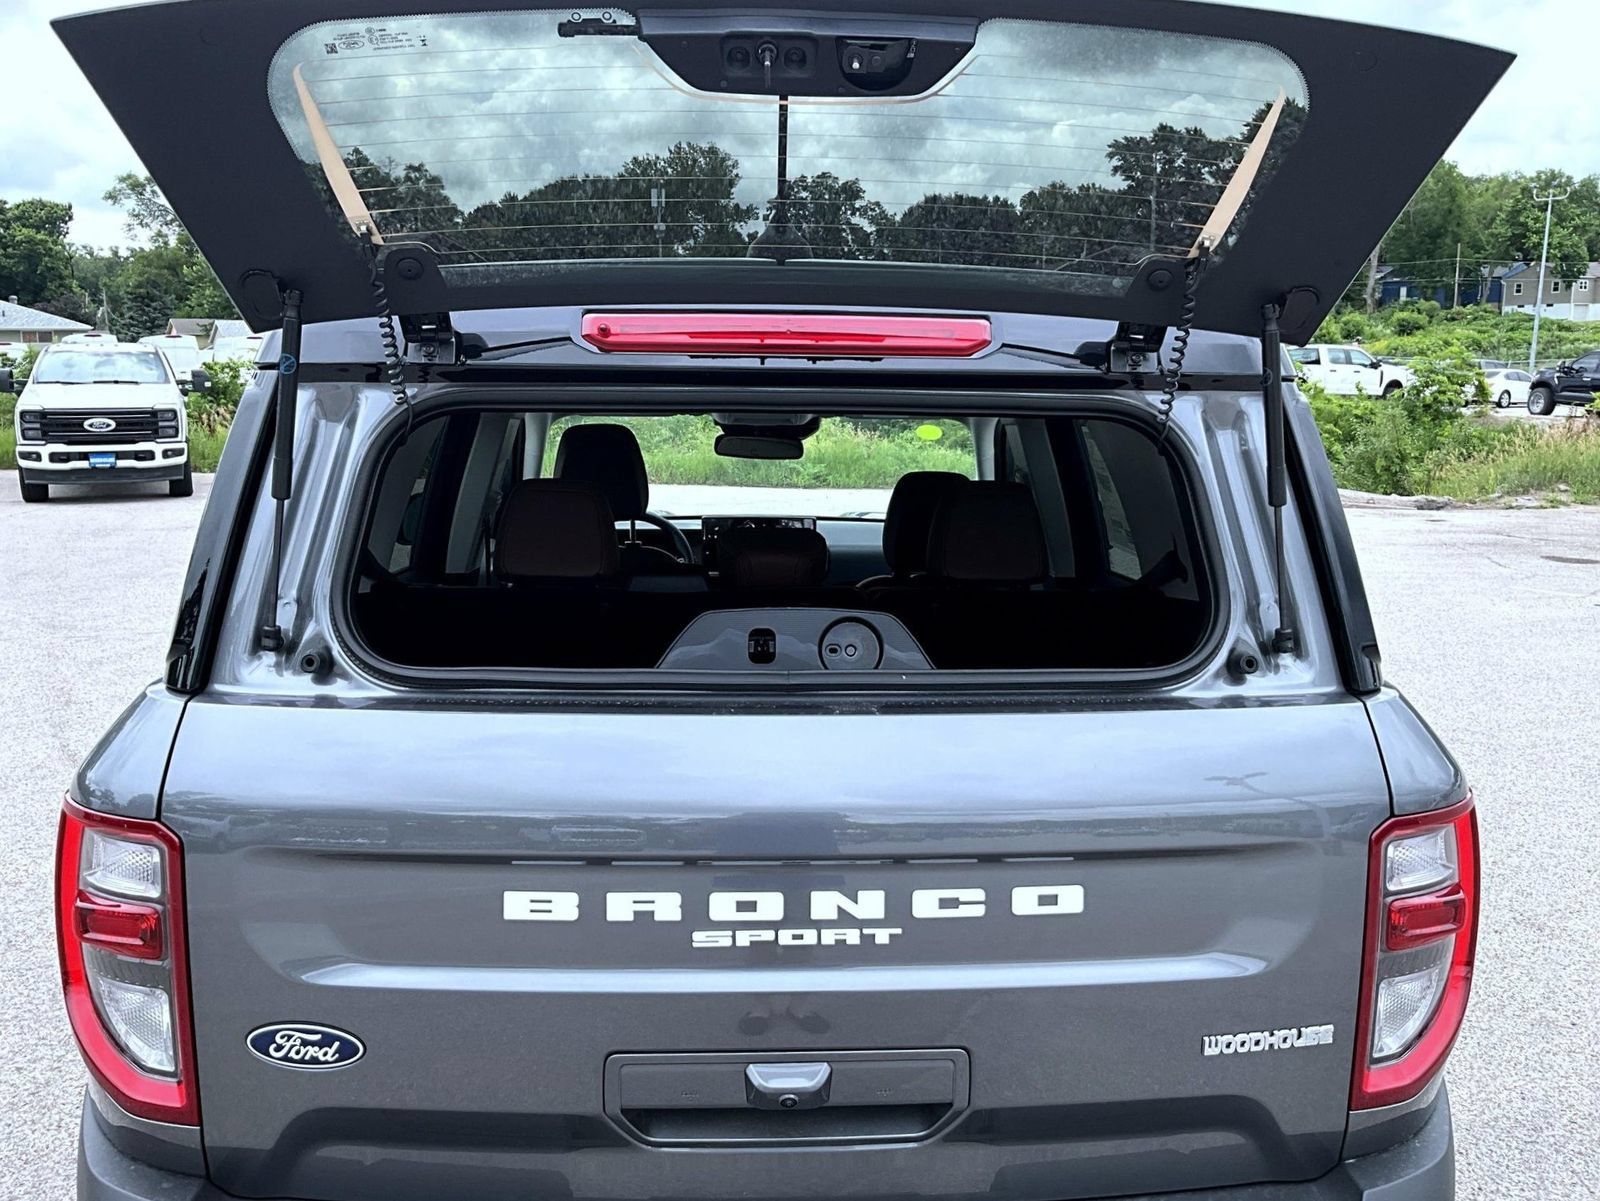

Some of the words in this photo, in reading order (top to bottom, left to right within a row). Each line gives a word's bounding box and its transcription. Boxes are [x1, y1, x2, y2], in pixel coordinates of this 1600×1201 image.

[503, 884, 1084, 922] BRONCO
[691, 927, 903, 948] SPORT
[268, 1030, 340, 1062] Ford
[1202, 1024, 1335, 1056] WOODHOUSE
